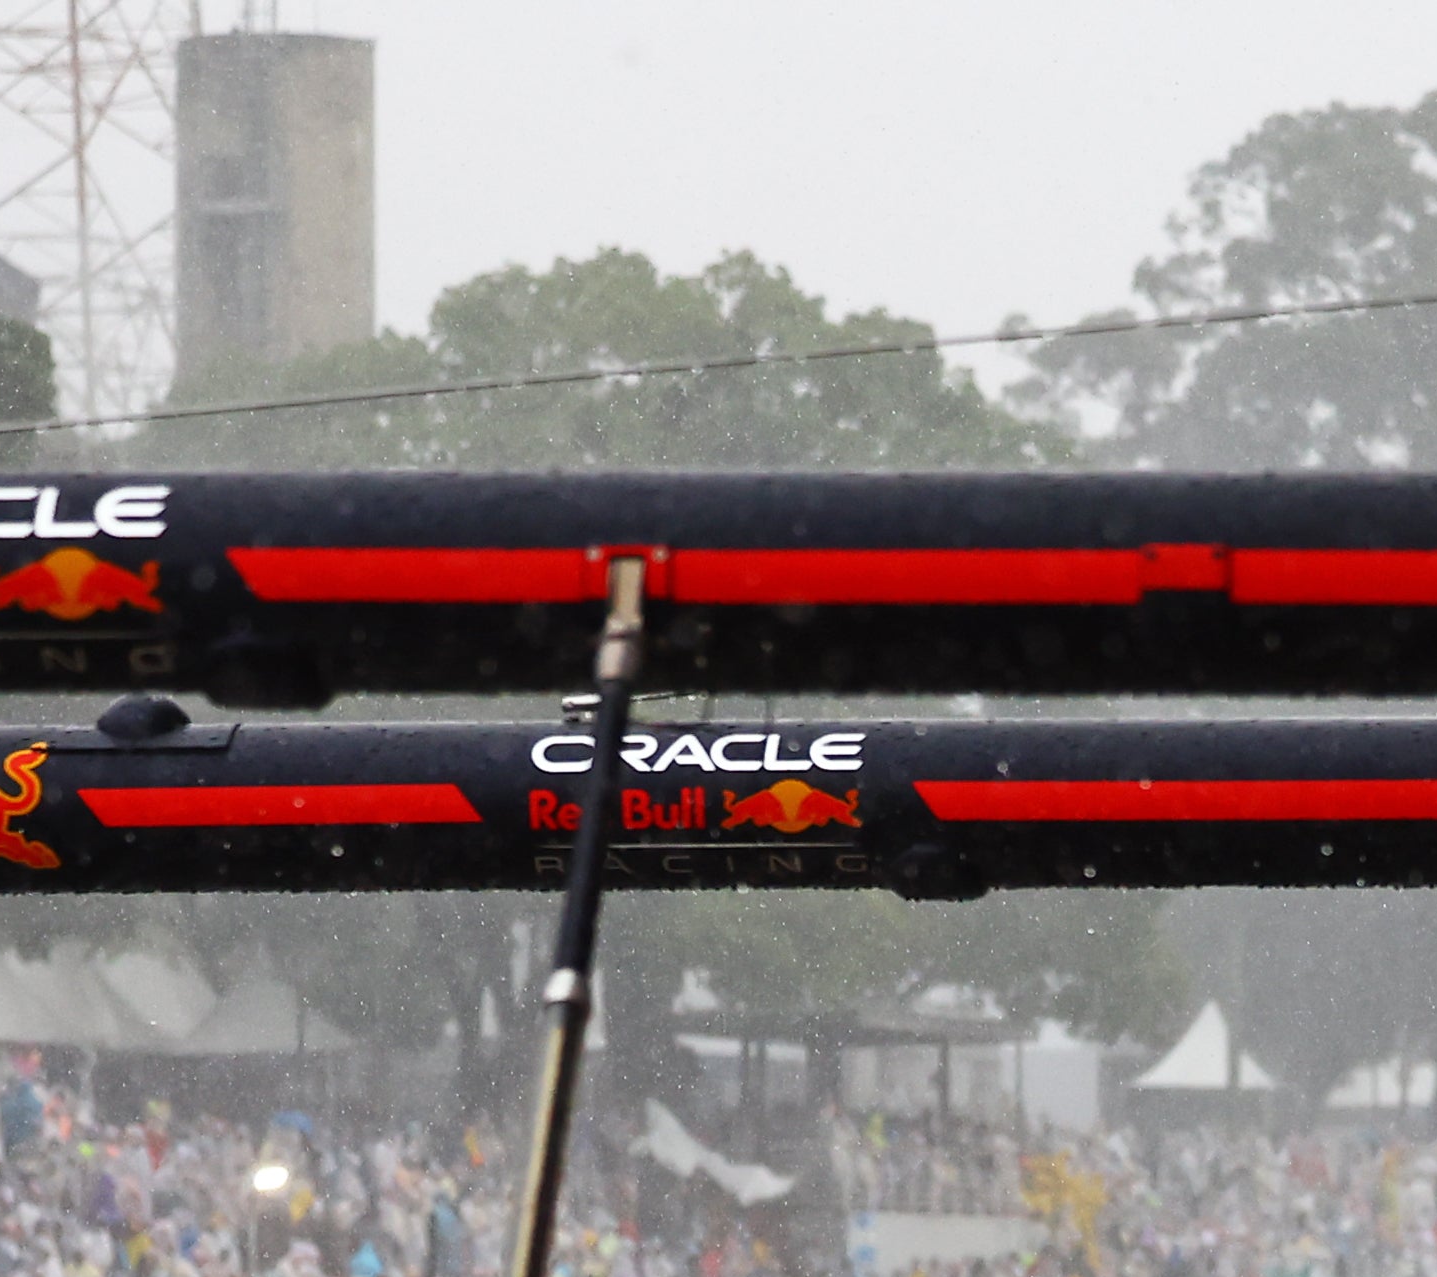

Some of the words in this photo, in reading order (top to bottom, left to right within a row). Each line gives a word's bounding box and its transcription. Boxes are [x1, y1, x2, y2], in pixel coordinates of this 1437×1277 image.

[530, 732, 868, 775] ORACLE
[528, 788, 585, 831] Re
[621, 786, 708, 831] Bull
[534, 854, 870, 876] RACING
